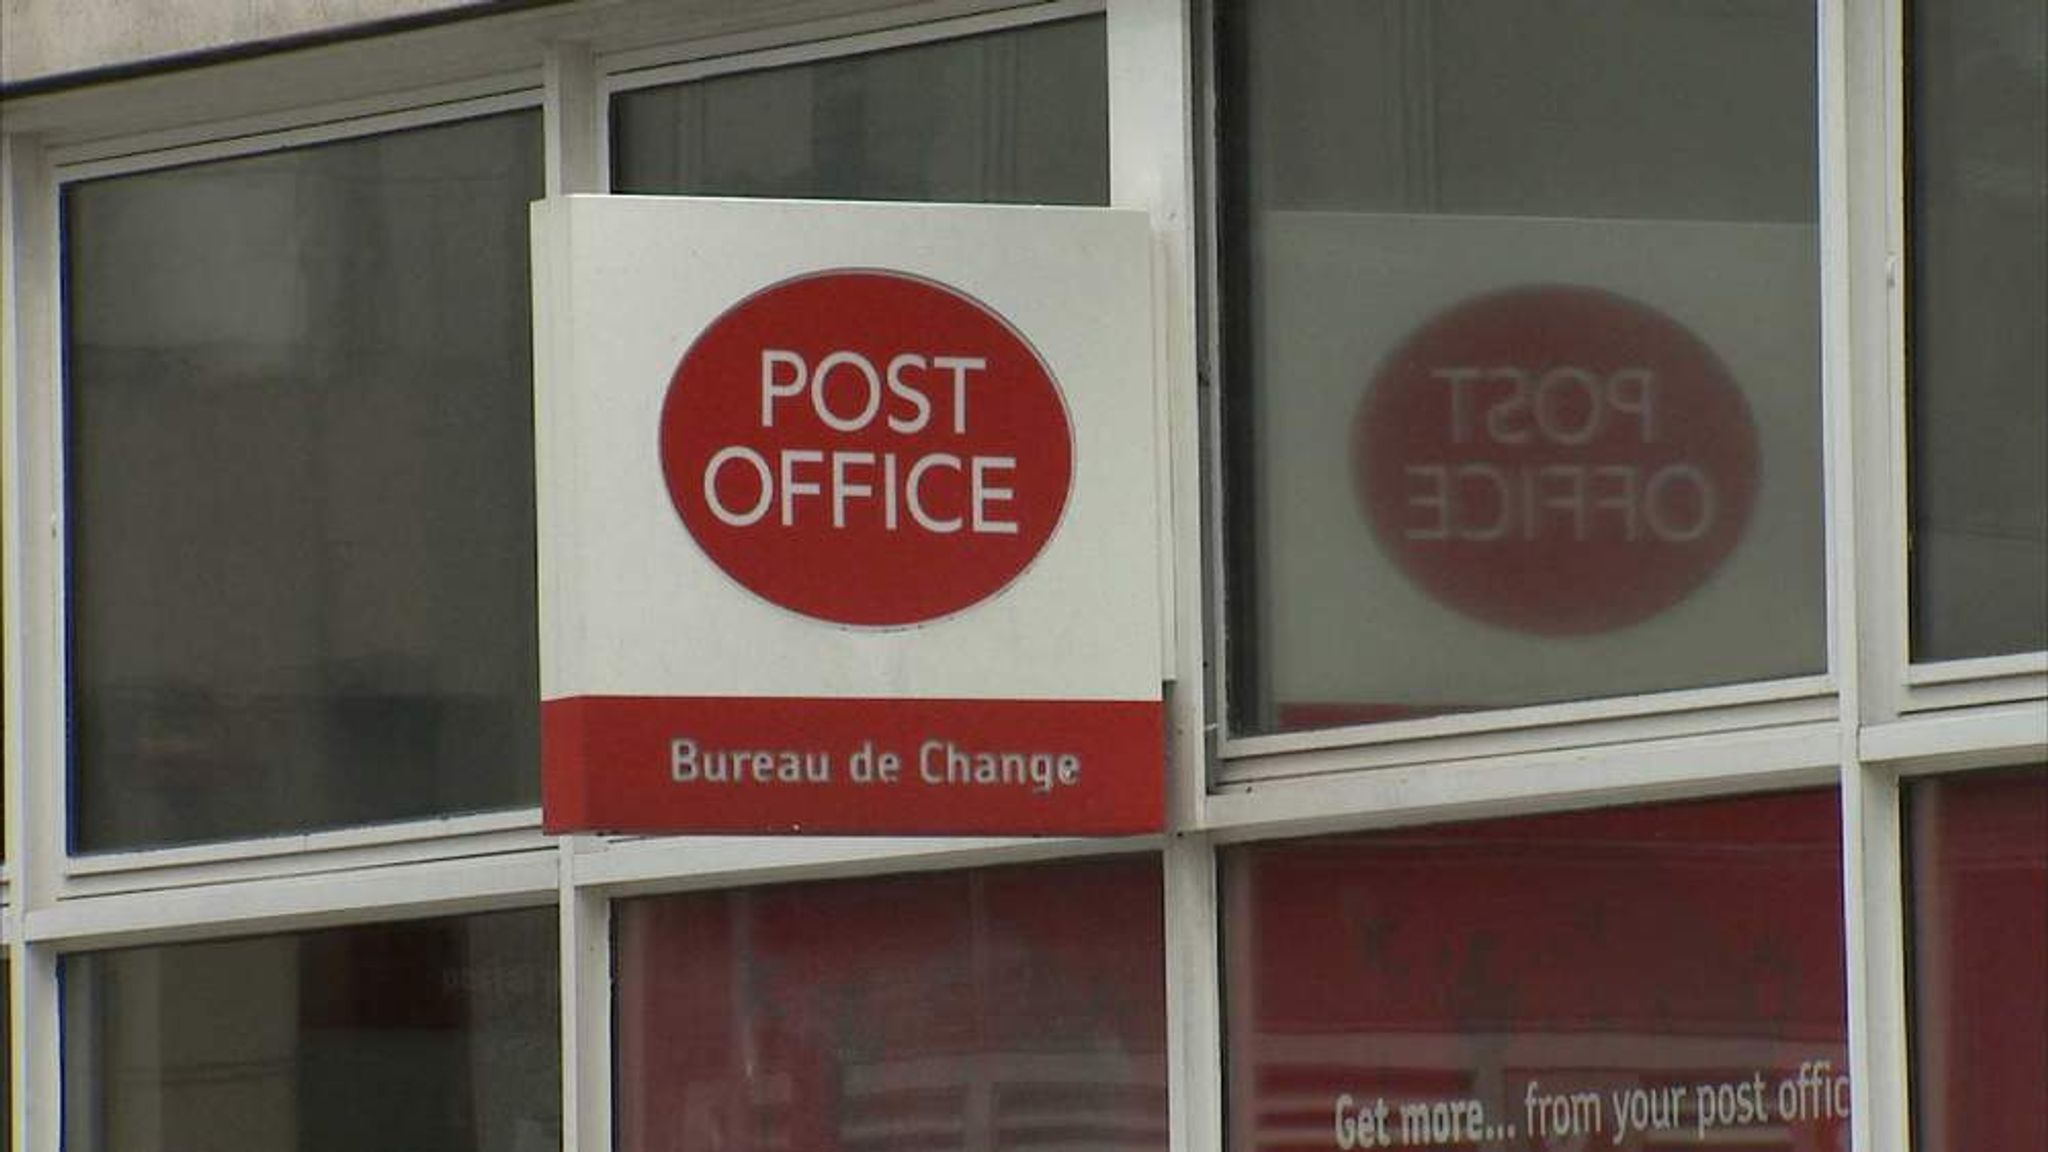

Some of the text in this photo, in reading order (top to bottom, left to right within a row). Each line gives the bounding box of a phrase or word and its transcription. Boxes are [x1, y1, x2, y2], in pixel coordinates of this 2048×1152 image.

[760, 349, 987, 435] POST
[703, 445, 1018, 534] OFFICE
[670, 738, 1081, 793] Bureau de Change
[1334, 1094, 1390, 1150] Get
[1400, 1099, 1516, 1144] more...
[1525, 1080, 1601, 1138] from
[1612, 1084, 1686, 1144] your
[1696, 1071, 1769, 1140] post
